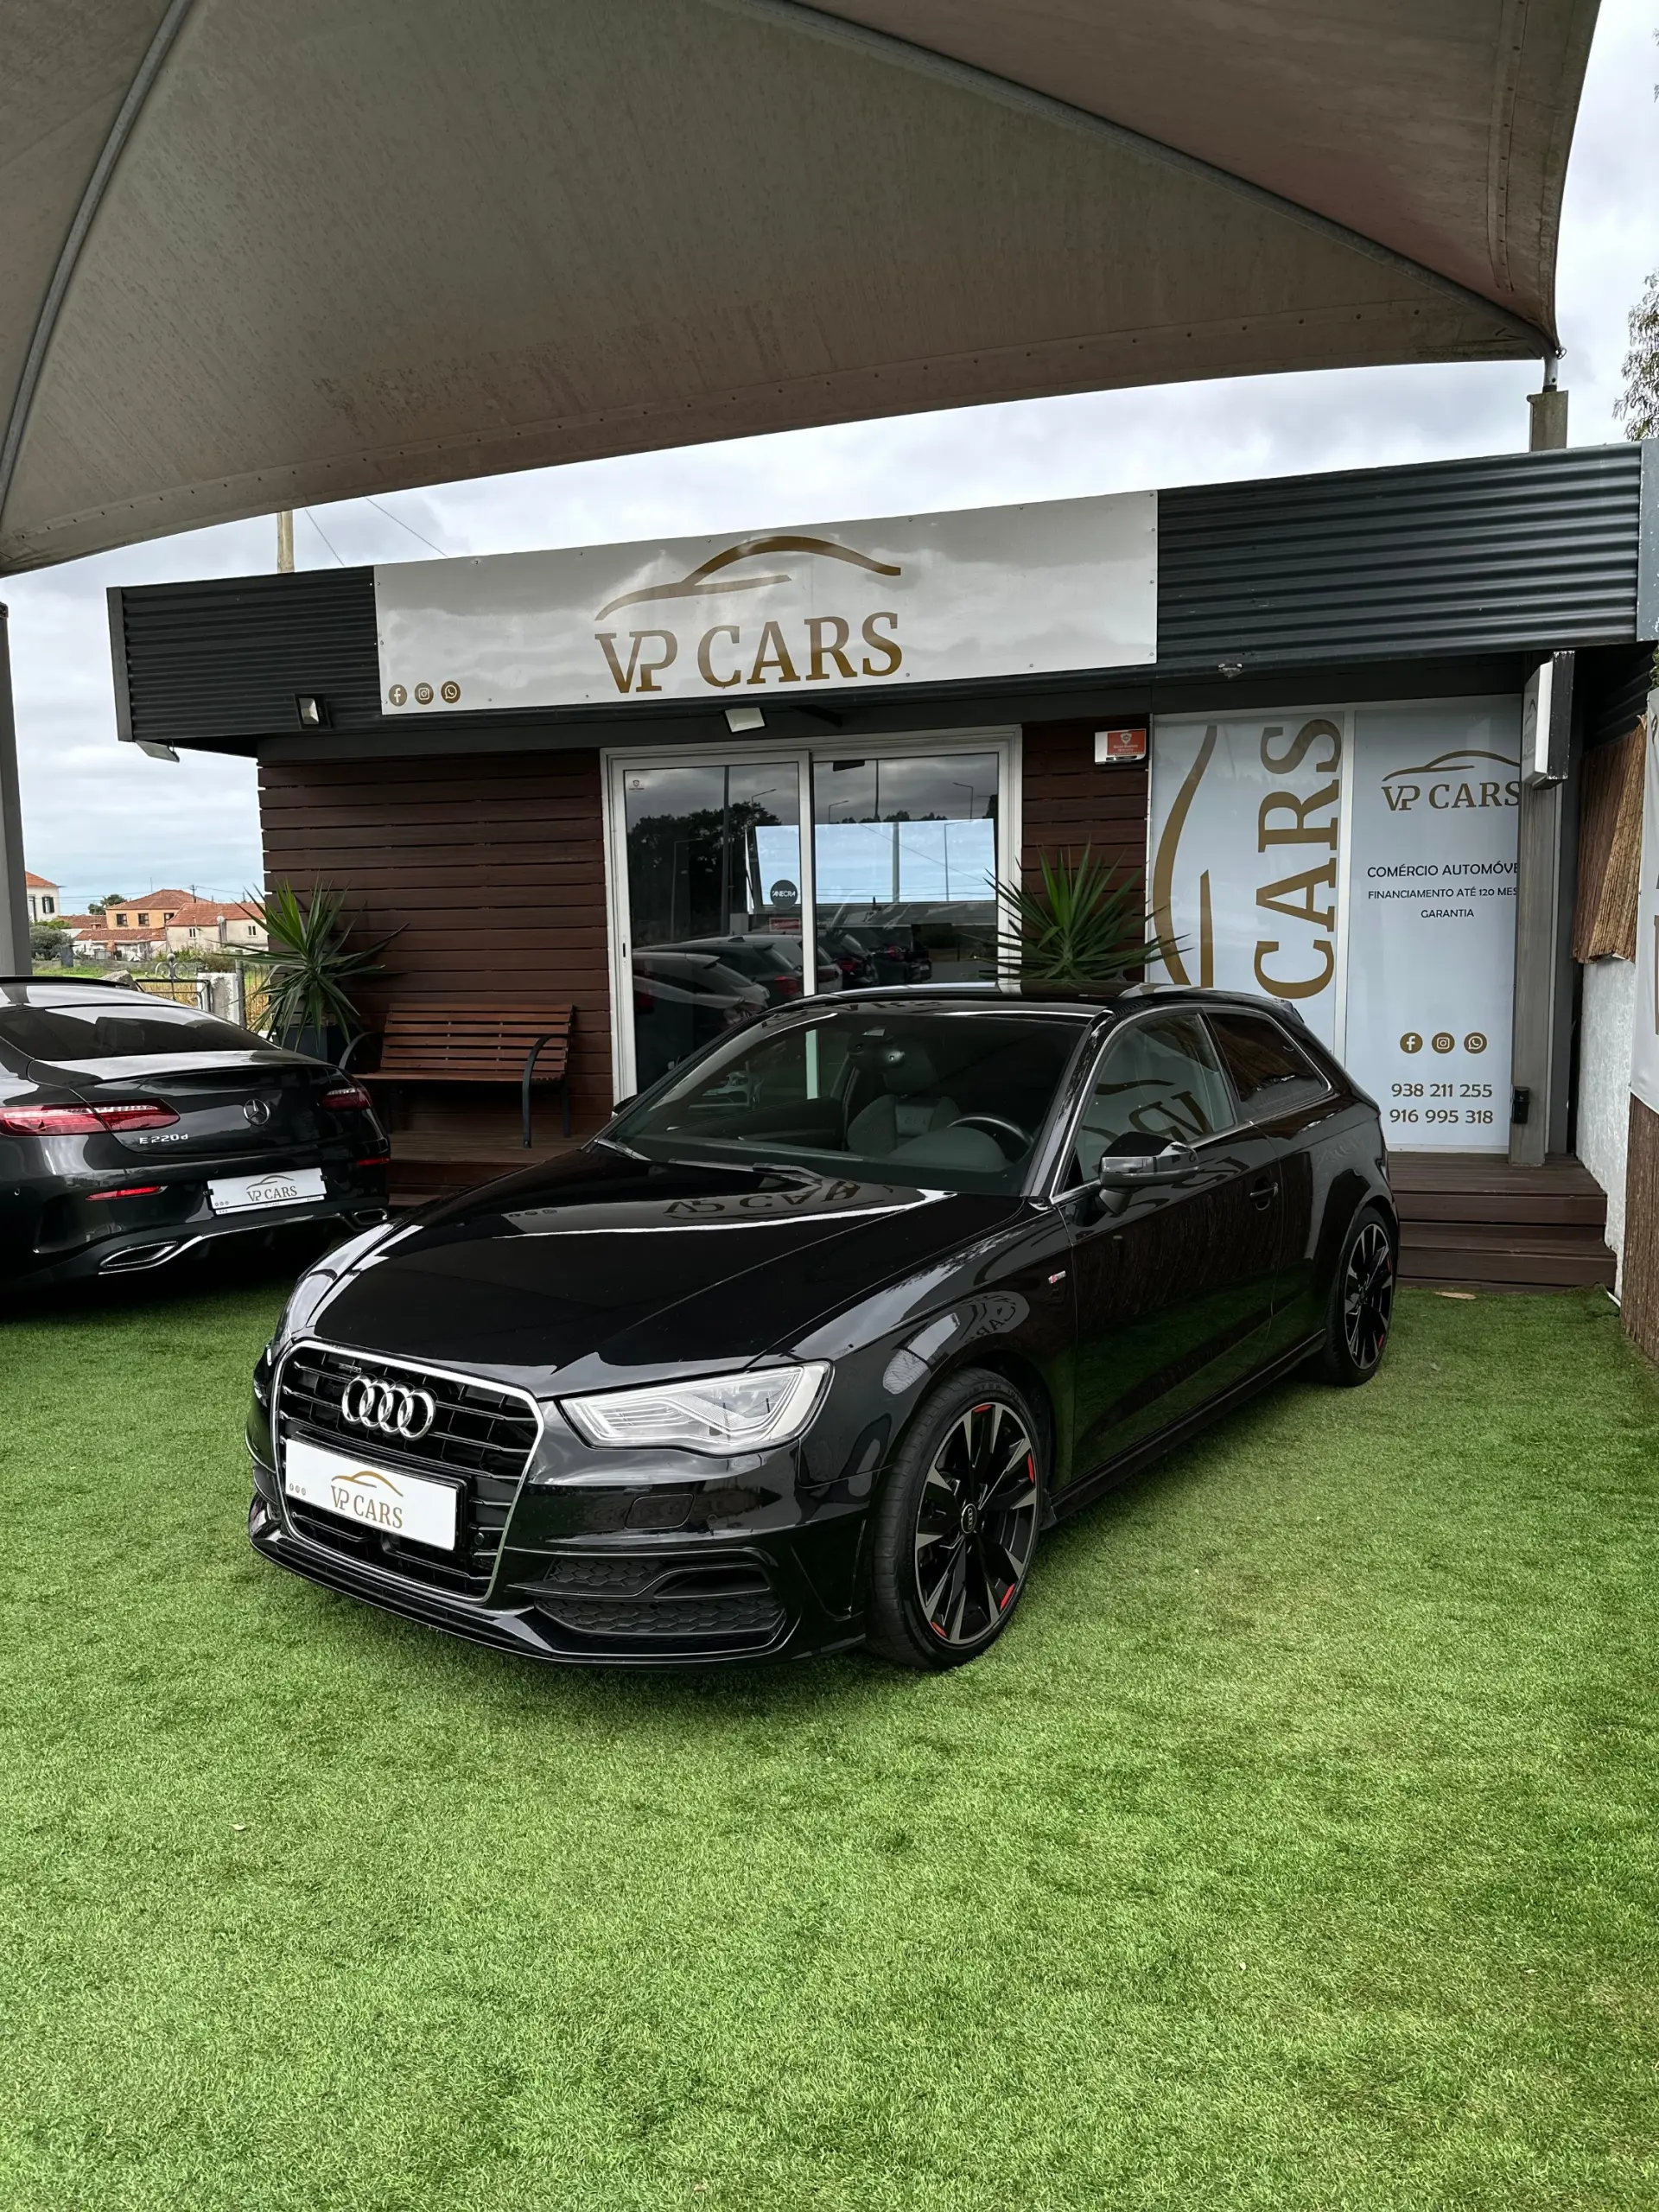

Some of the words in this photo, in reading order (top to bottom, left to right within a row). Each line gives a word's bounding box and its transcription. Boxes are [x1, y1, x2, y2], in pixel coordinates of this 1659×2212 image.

[594, 628, 677, 694] VP
[697, 612, 903, 689] CARS
[1381, 785, 1421, 811] VP
[1428, 781, 1520, 810] CARS
[1254, 719, 1342, 999] CARS
[1367, 863, 1439, 878] COMÉRCIO
[1368, 888, 1454, 899] FINANCIAMENTO
[1457, 887, 1477, 897] ATÉ
[1479, 887, 1495, 897] 120
[1421, 909, 1474, 918] GARANTIA
[1391, 1083, 1424, 1097] 938
[1430, 1084, 1453, 1097] 211
[1459, 1084, 1492, 1097] 255
[1389, 1109, 1419, 1122] 916
[1425, 1109, 1459, 1123] 995
[1465, 1109, 1493, 1124] 318
[246, 1190, 262, 1202] VP
[264, 1185, 297, 1199] CARS
[331, 1484, 350, 1510] VP
[353, 1495, 403, 1529] CARS
